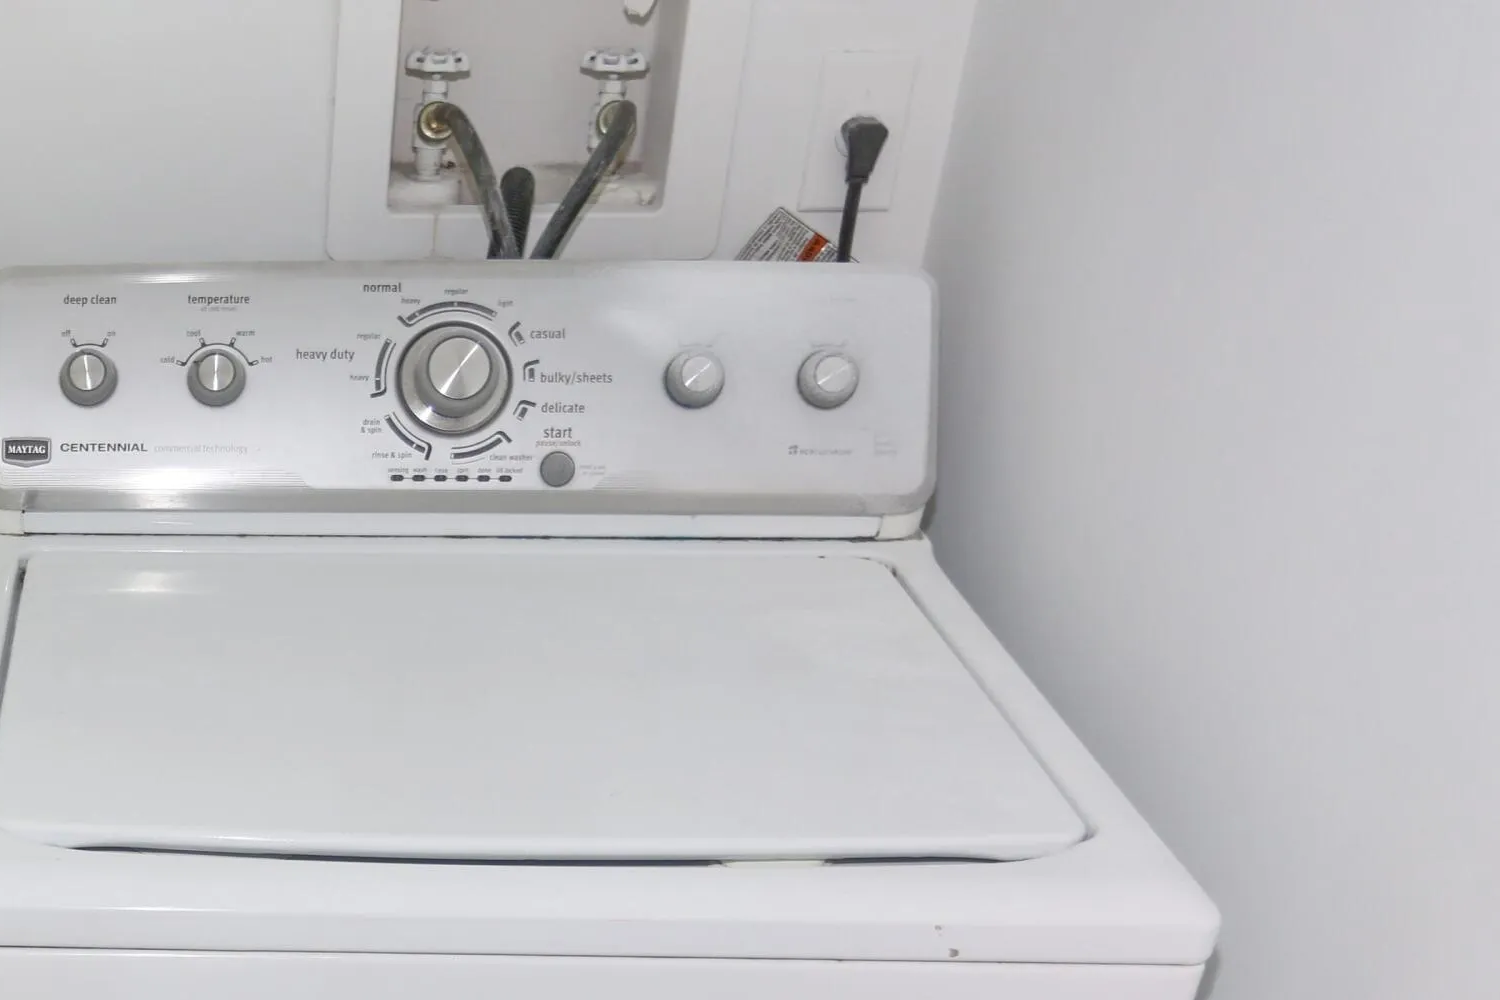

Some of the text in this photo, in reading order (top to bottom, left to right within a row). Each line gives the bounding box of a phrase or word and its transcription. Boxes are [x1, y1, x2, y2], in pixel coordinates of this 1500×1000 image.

[363, 282, 402, 293] normal
[63, 294, 117, 308] deep clean
[187, 294, 250, 306] temperature
[530, 327, 567, 340] casual
[295, 348, 355, 362] heavy duty
[539, 370, 613, 385] bulky/sheets
[541, 401, 586, 414] delicate
[362, 418, 380, 426] drain
[543, 426, 573, 439] start
[7, 445, 46, 455] MAYTAG
[60, 443, 148, 453] CENTENNIAL
[202, 443, 248, 455] technology
[390, 451, 397, 459] &
